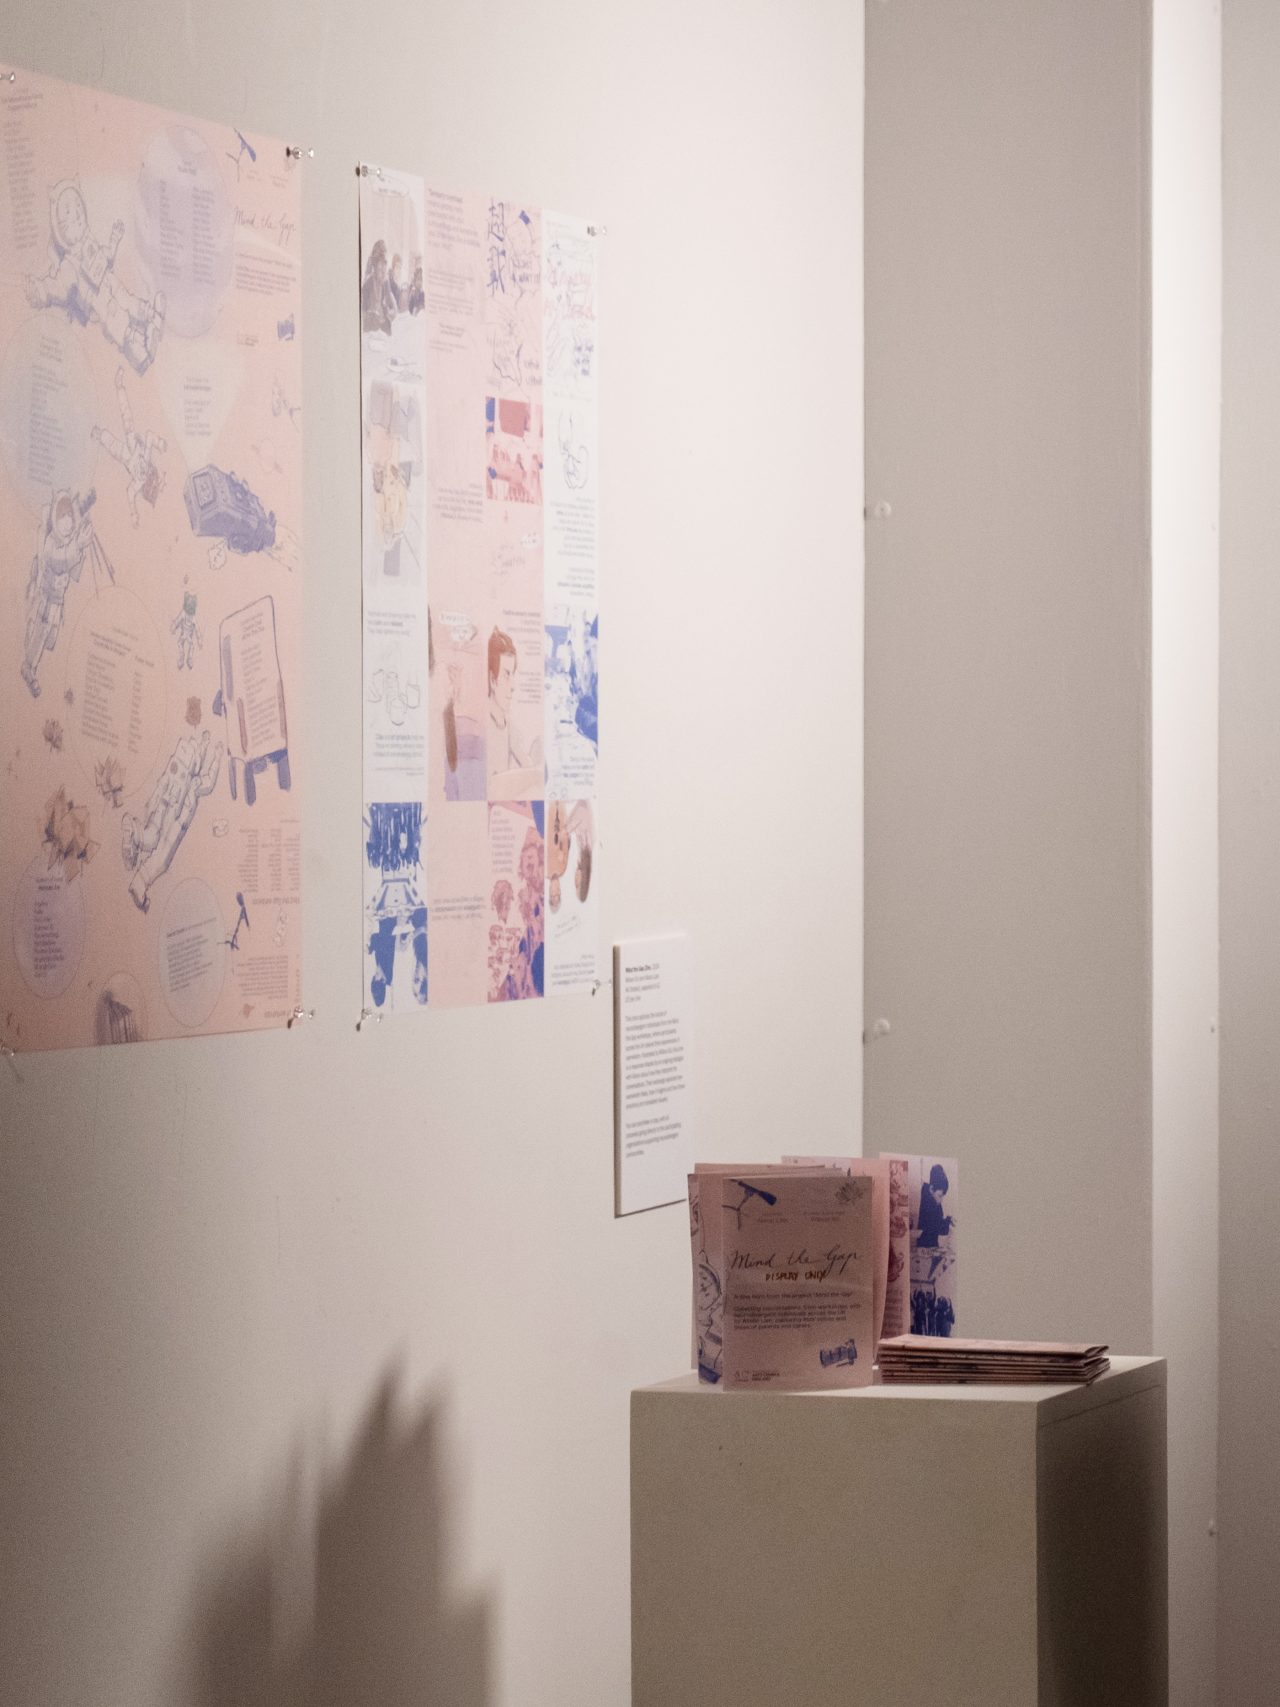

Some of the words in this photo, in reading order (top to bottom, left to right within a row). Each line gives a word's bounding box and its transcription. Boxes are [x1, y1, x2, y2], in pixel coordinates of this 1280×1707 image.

[730, 1249, 776, 1269] Mind
[787, 1249, 812, 1266] the
[824, 1243, 857, 1278] Gap
[765, 1271, 799, 1281] DISPLAY
